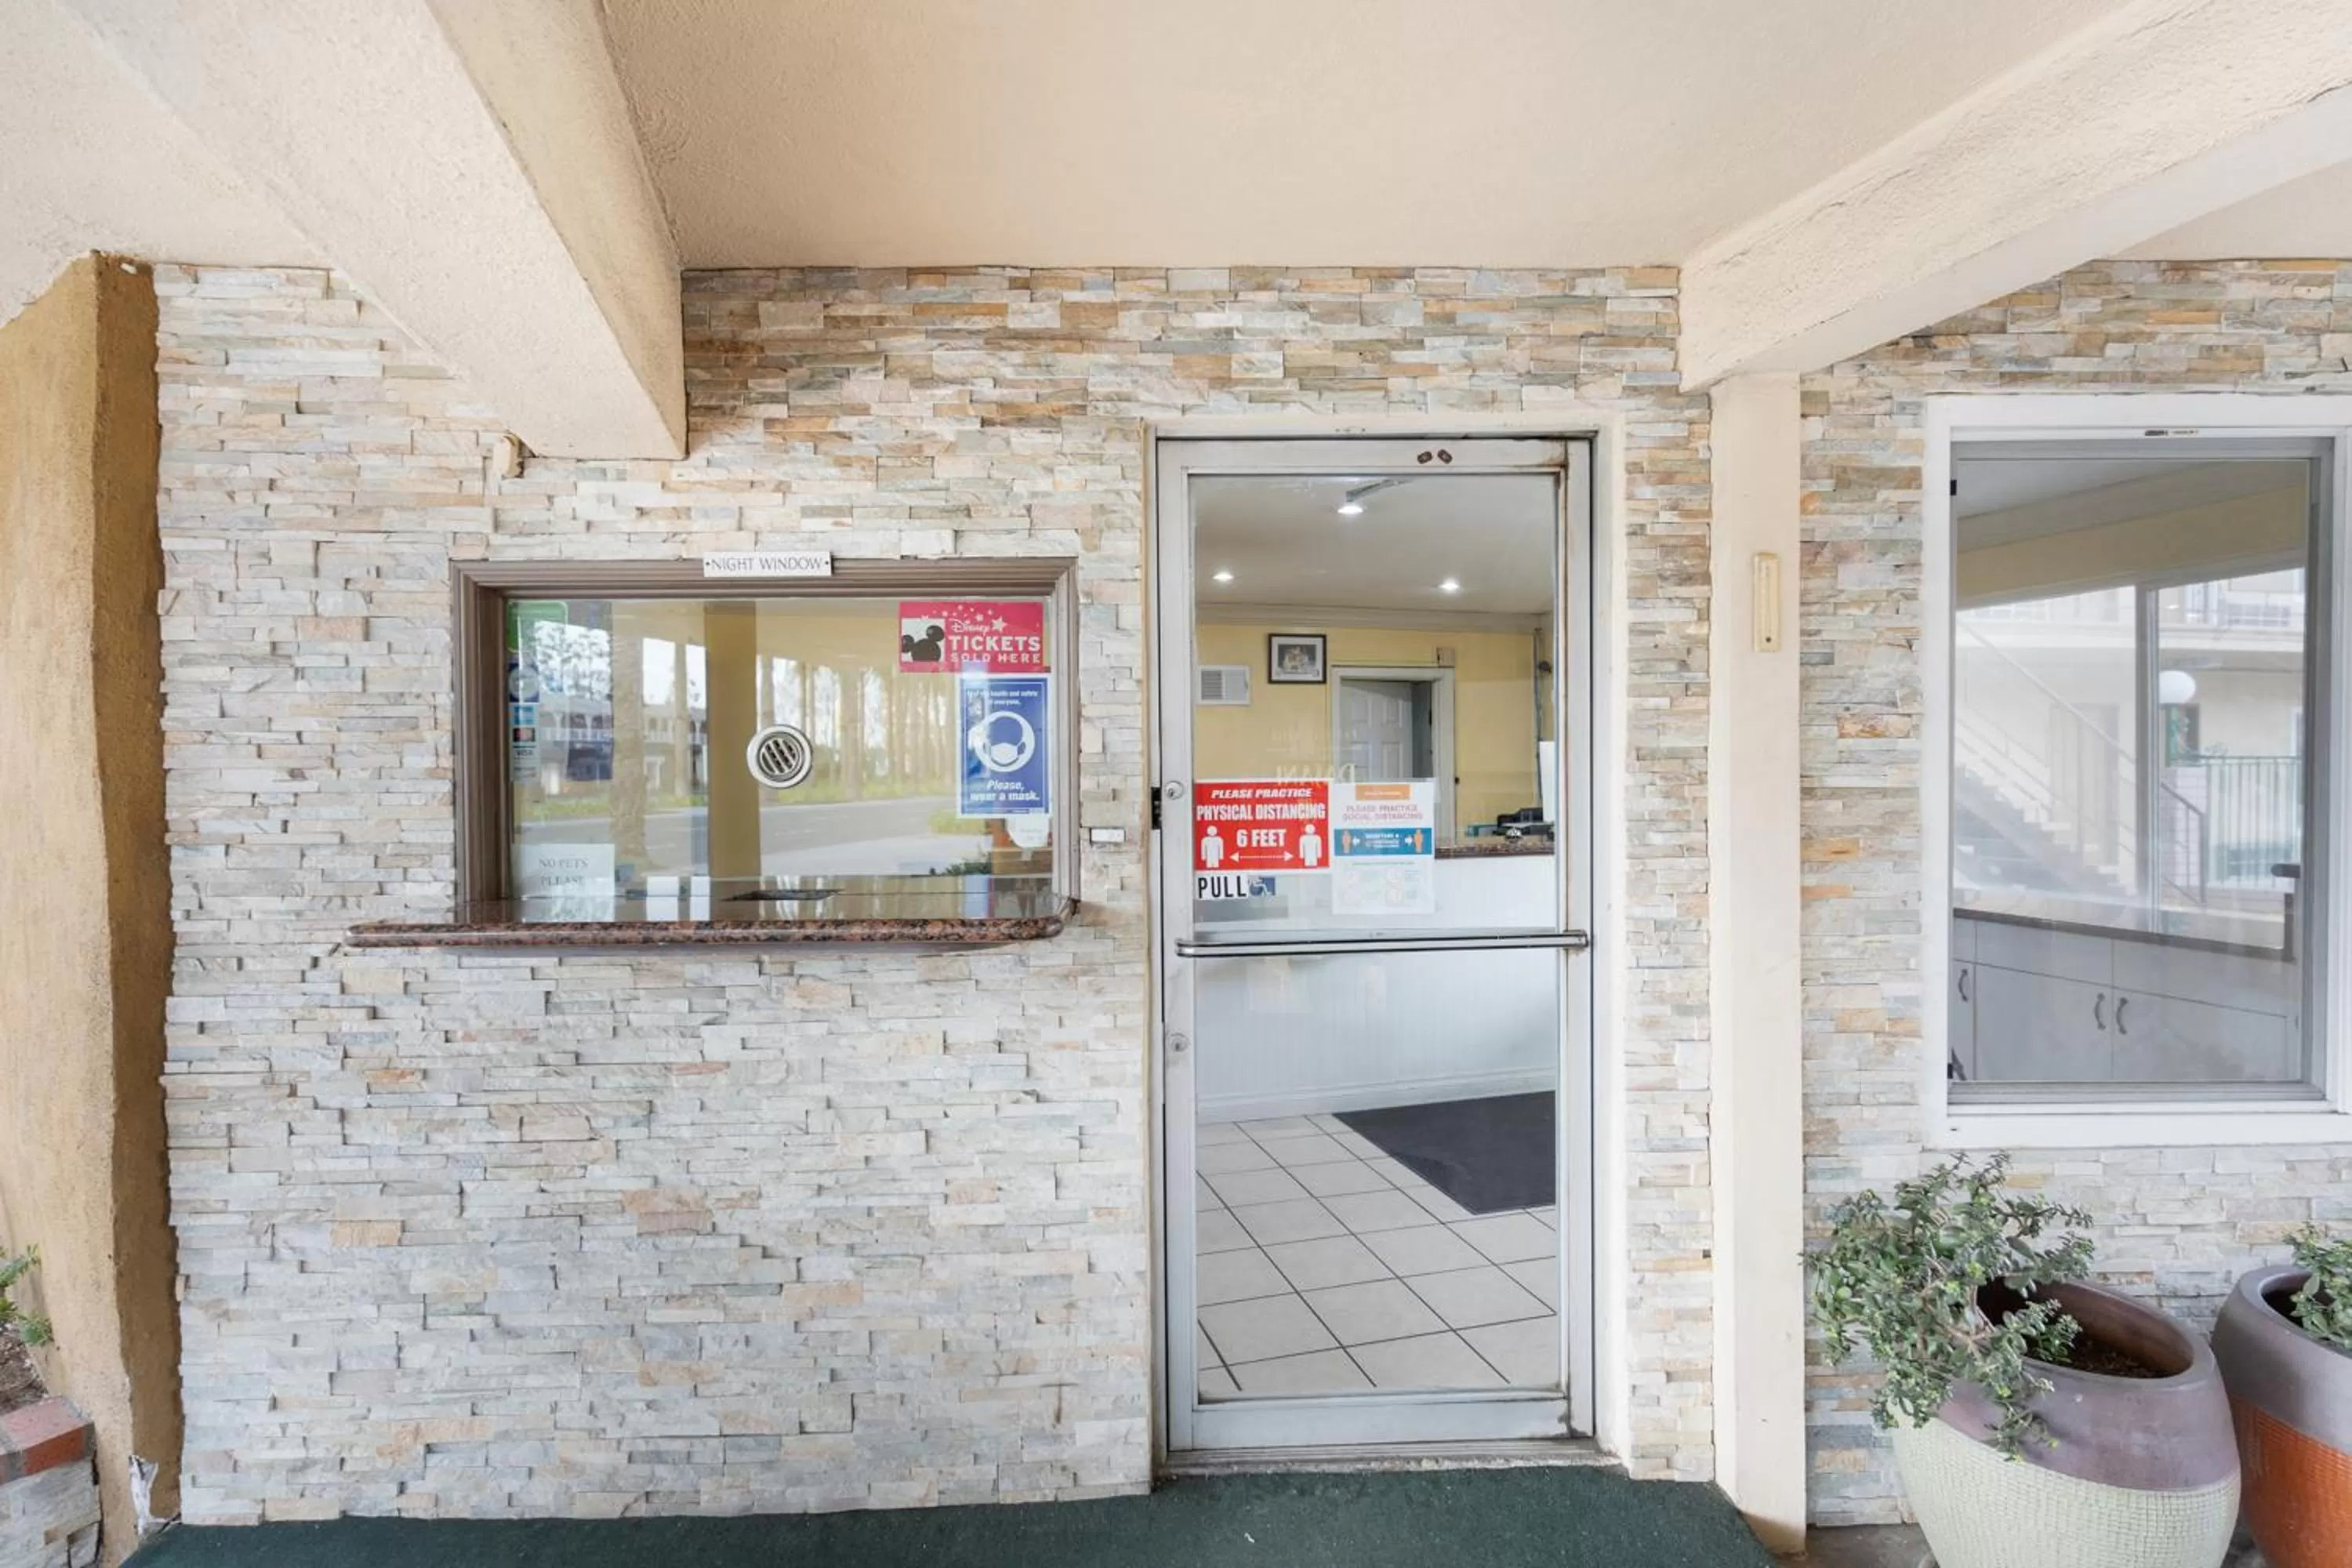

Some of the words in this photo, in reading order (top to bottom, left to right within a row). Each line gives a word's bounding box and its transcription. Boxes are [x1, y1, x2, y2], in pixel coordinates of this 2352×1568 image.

[711, 557, 754, 571] NIGHT
[758, 557, 822, 571] WINDOW
[949, 618, 990, 636] Disney
[949, 636, 1041, 652] TICKETS
[950, 652, 991, 662] SOLD
[998, 653, 1041, 663] HERE
[986, 779, 1025, 791] Please,
[970, 793, 996, 801] wear
[998, 793, 1006, 801] a
[1007, 790, 1040, 801] mask.
[1210, 789, 1253, 799] PLEASE
[1255, 788, 1313, 798] PRACTICE
[1196, 804, 1254, 821] PHYSICAL
[1255, 803, 1326, 820] DISTANCING
[1236, 829, 1248, 848] 6
[1251, 829, 1287, 848] FEET
[539, 858, 556, 868] NO
[559, 858, 589, 868] PETS
[1198, 876, 1247, 898] PULL
